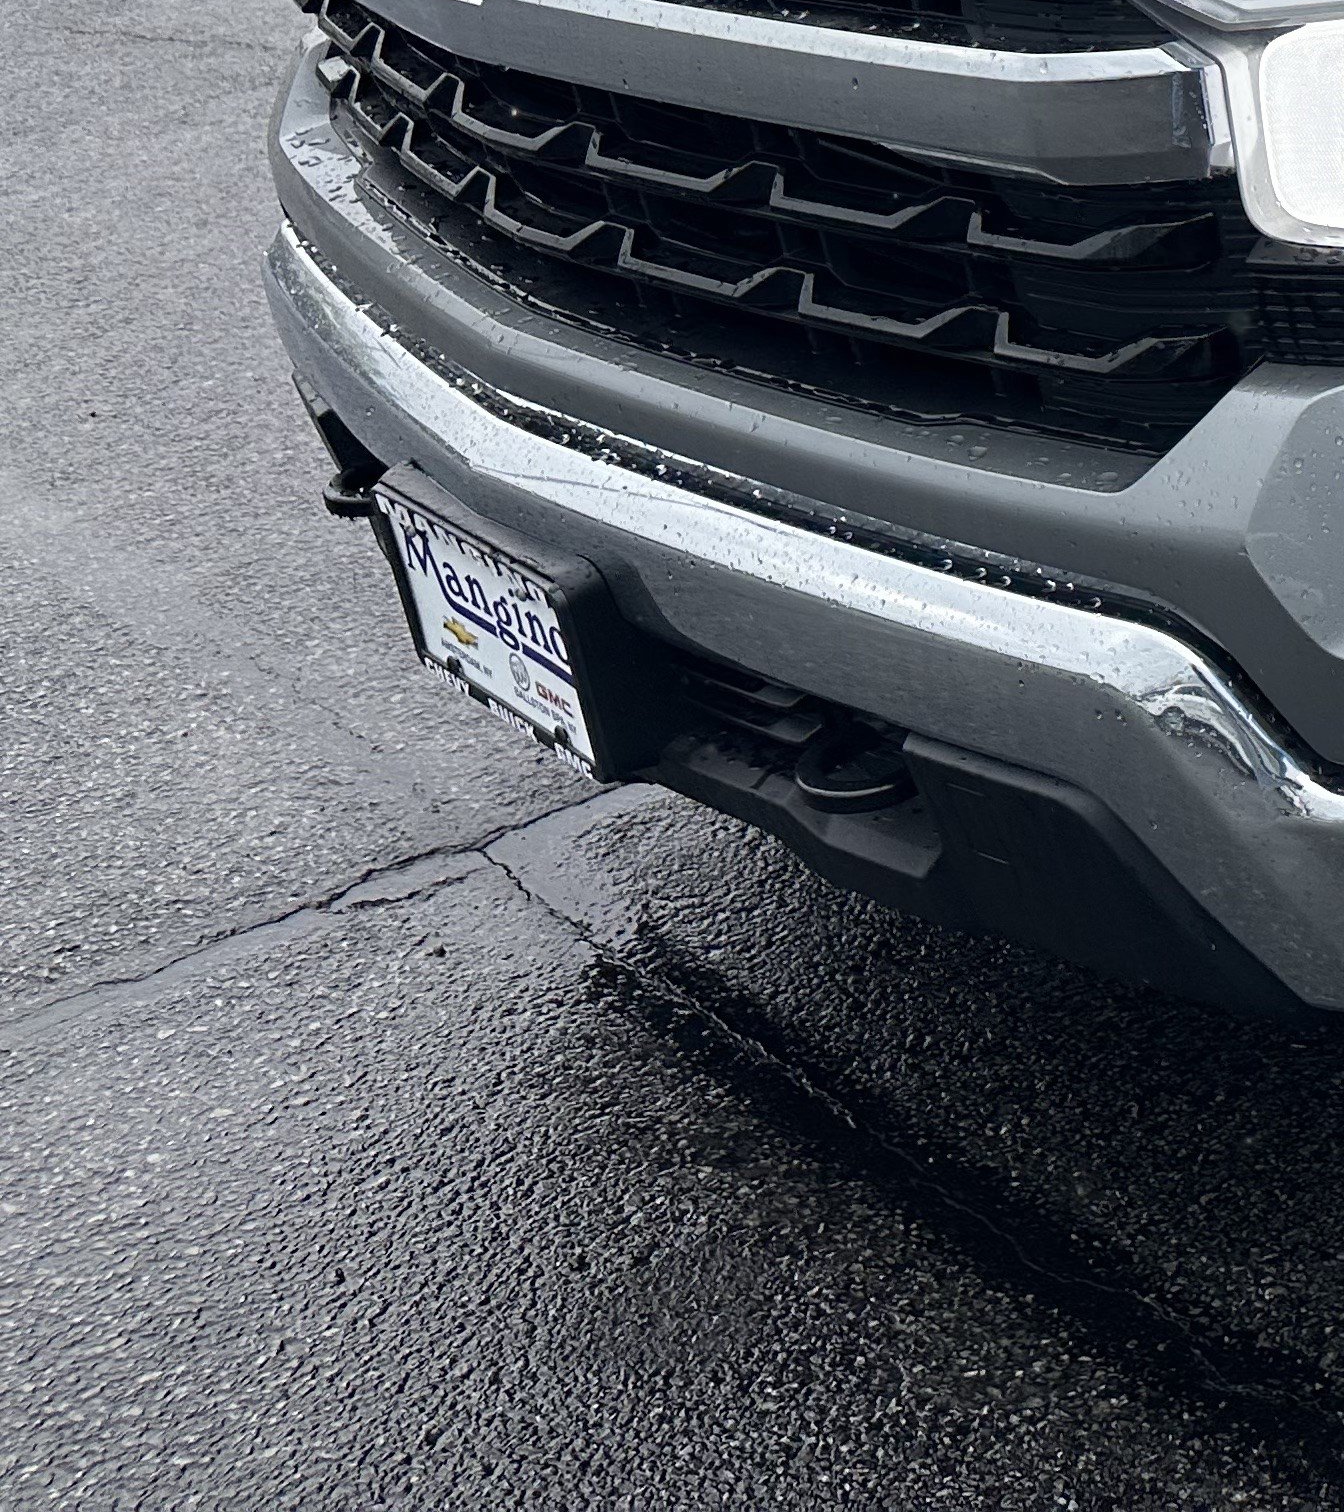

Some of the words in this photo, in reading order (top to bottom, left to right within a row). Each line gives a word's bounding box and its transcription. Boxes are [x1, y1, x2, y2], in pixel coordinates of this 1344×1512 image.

[399, 522, 570, 665] Mangino
[424, 656, 470, 697] CHEVY
[487, 696, 538, 744] BUICK
[554, 742, 593, 780] GMC
[535, 681, 574, 718] GMC
